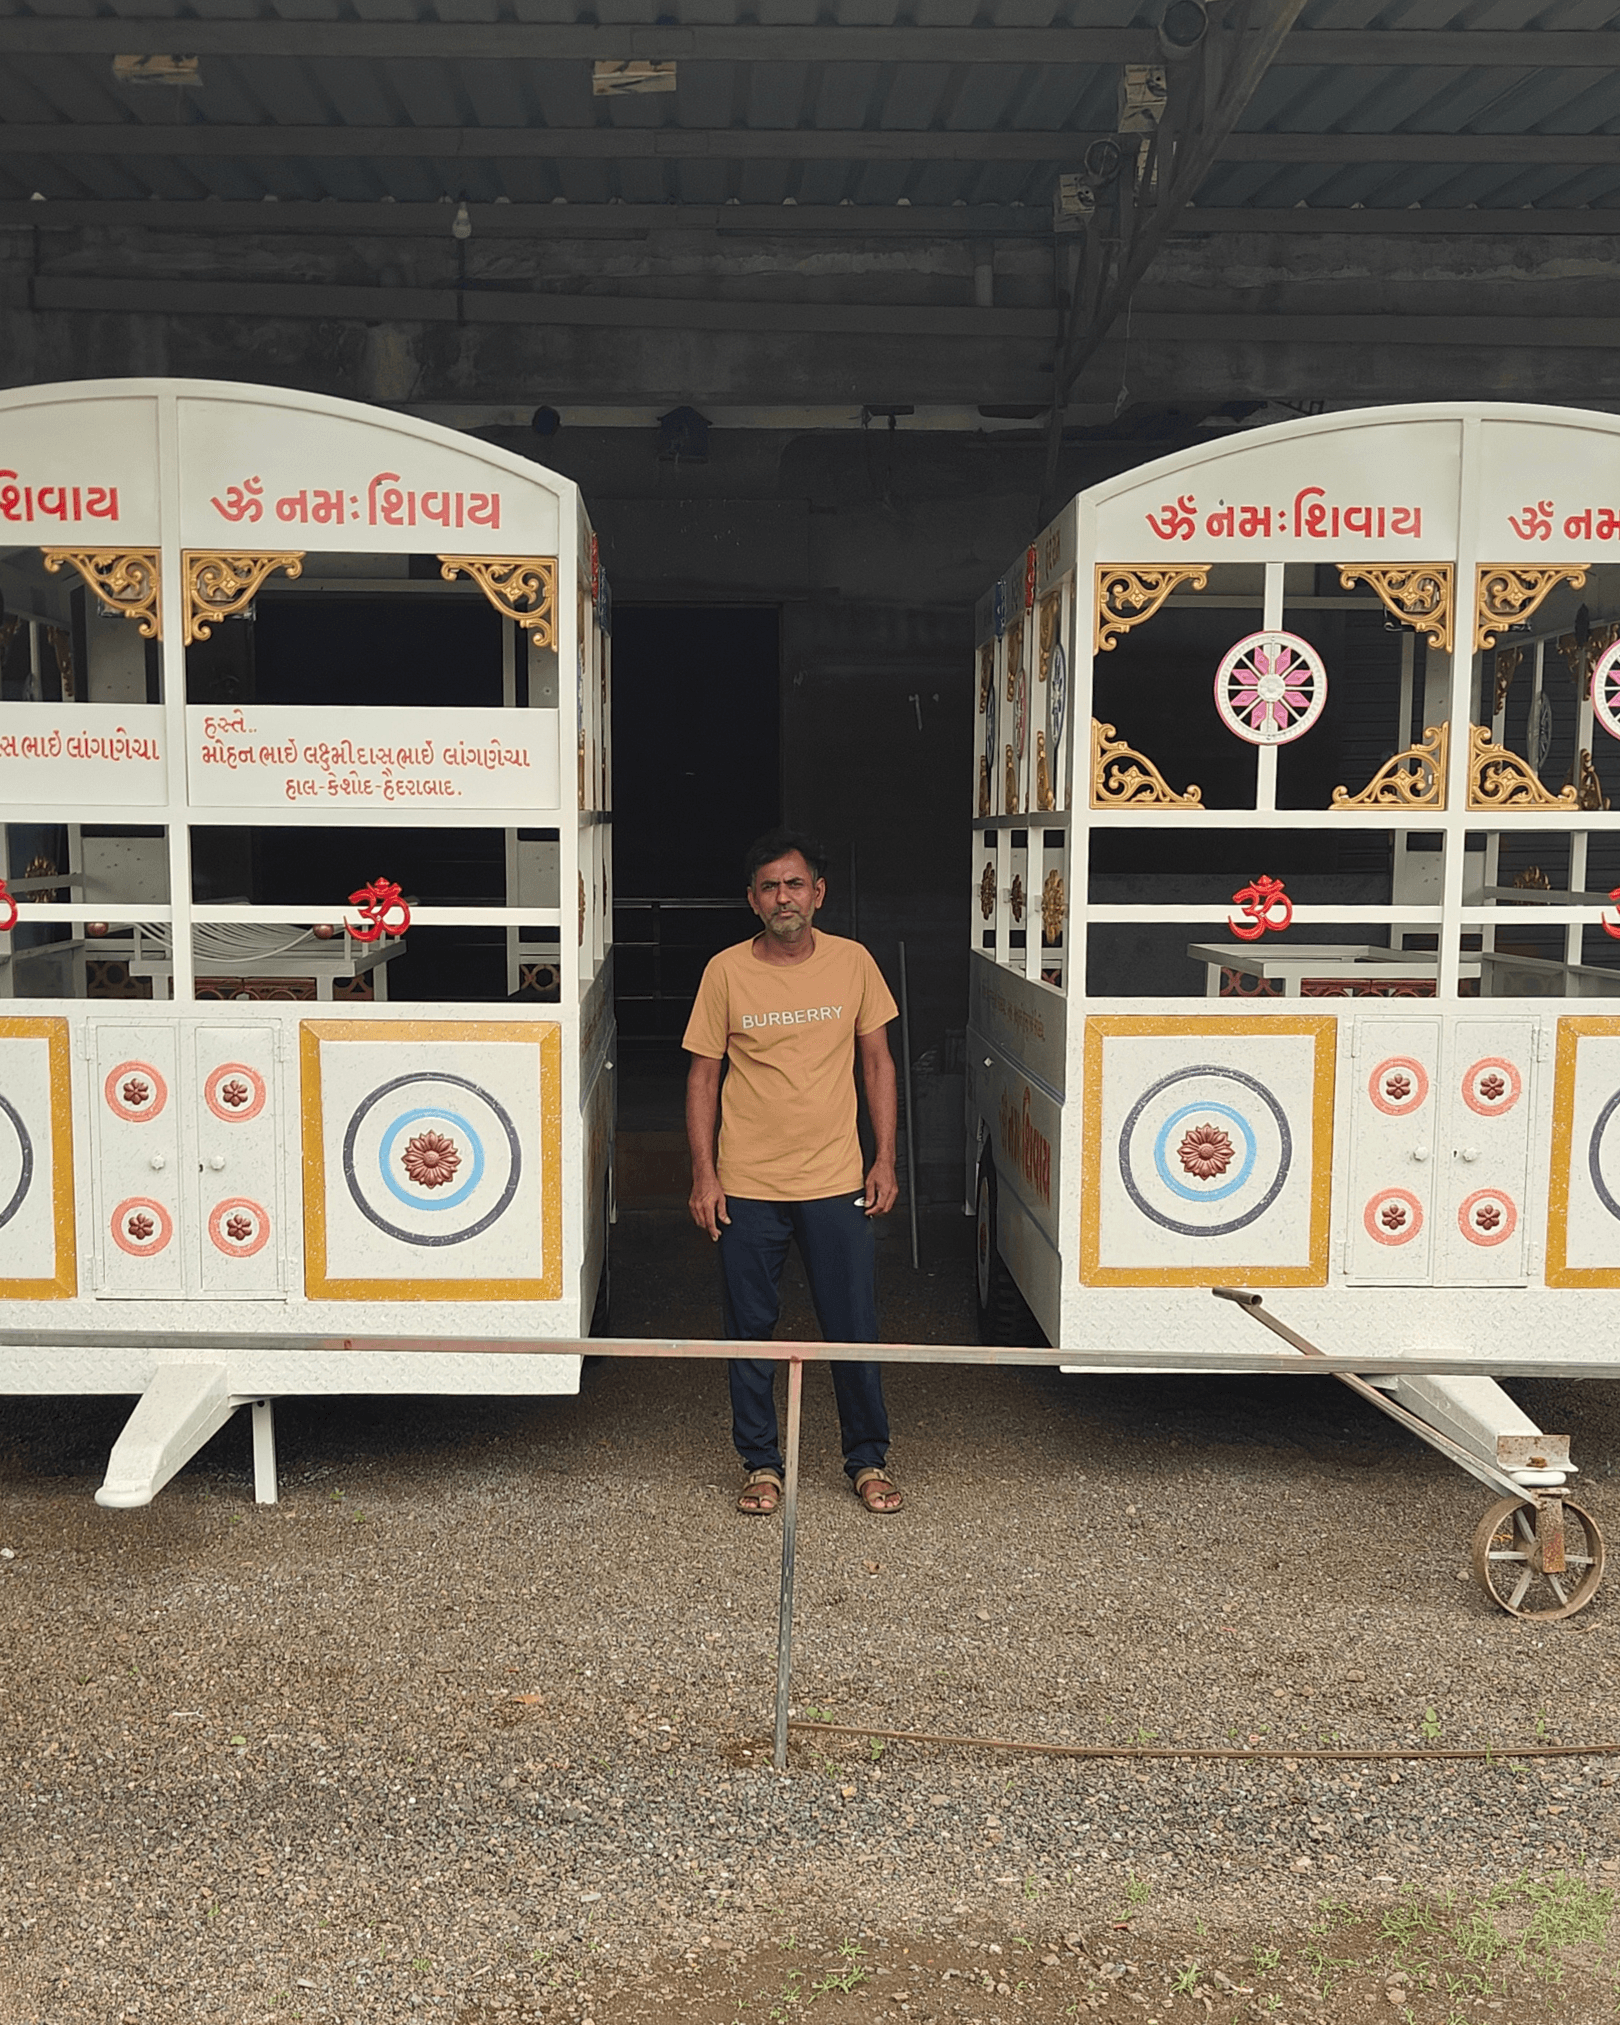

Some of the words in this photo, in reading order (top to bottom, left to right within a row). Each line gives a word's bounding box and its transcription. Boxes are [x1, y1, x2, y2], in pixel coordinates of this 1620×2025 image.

[367, 471, 501, 530] શિવાય
[1293, 485, 1422, 539] શિવાય
[741, 1005, 843, 1030] BURBERRY
